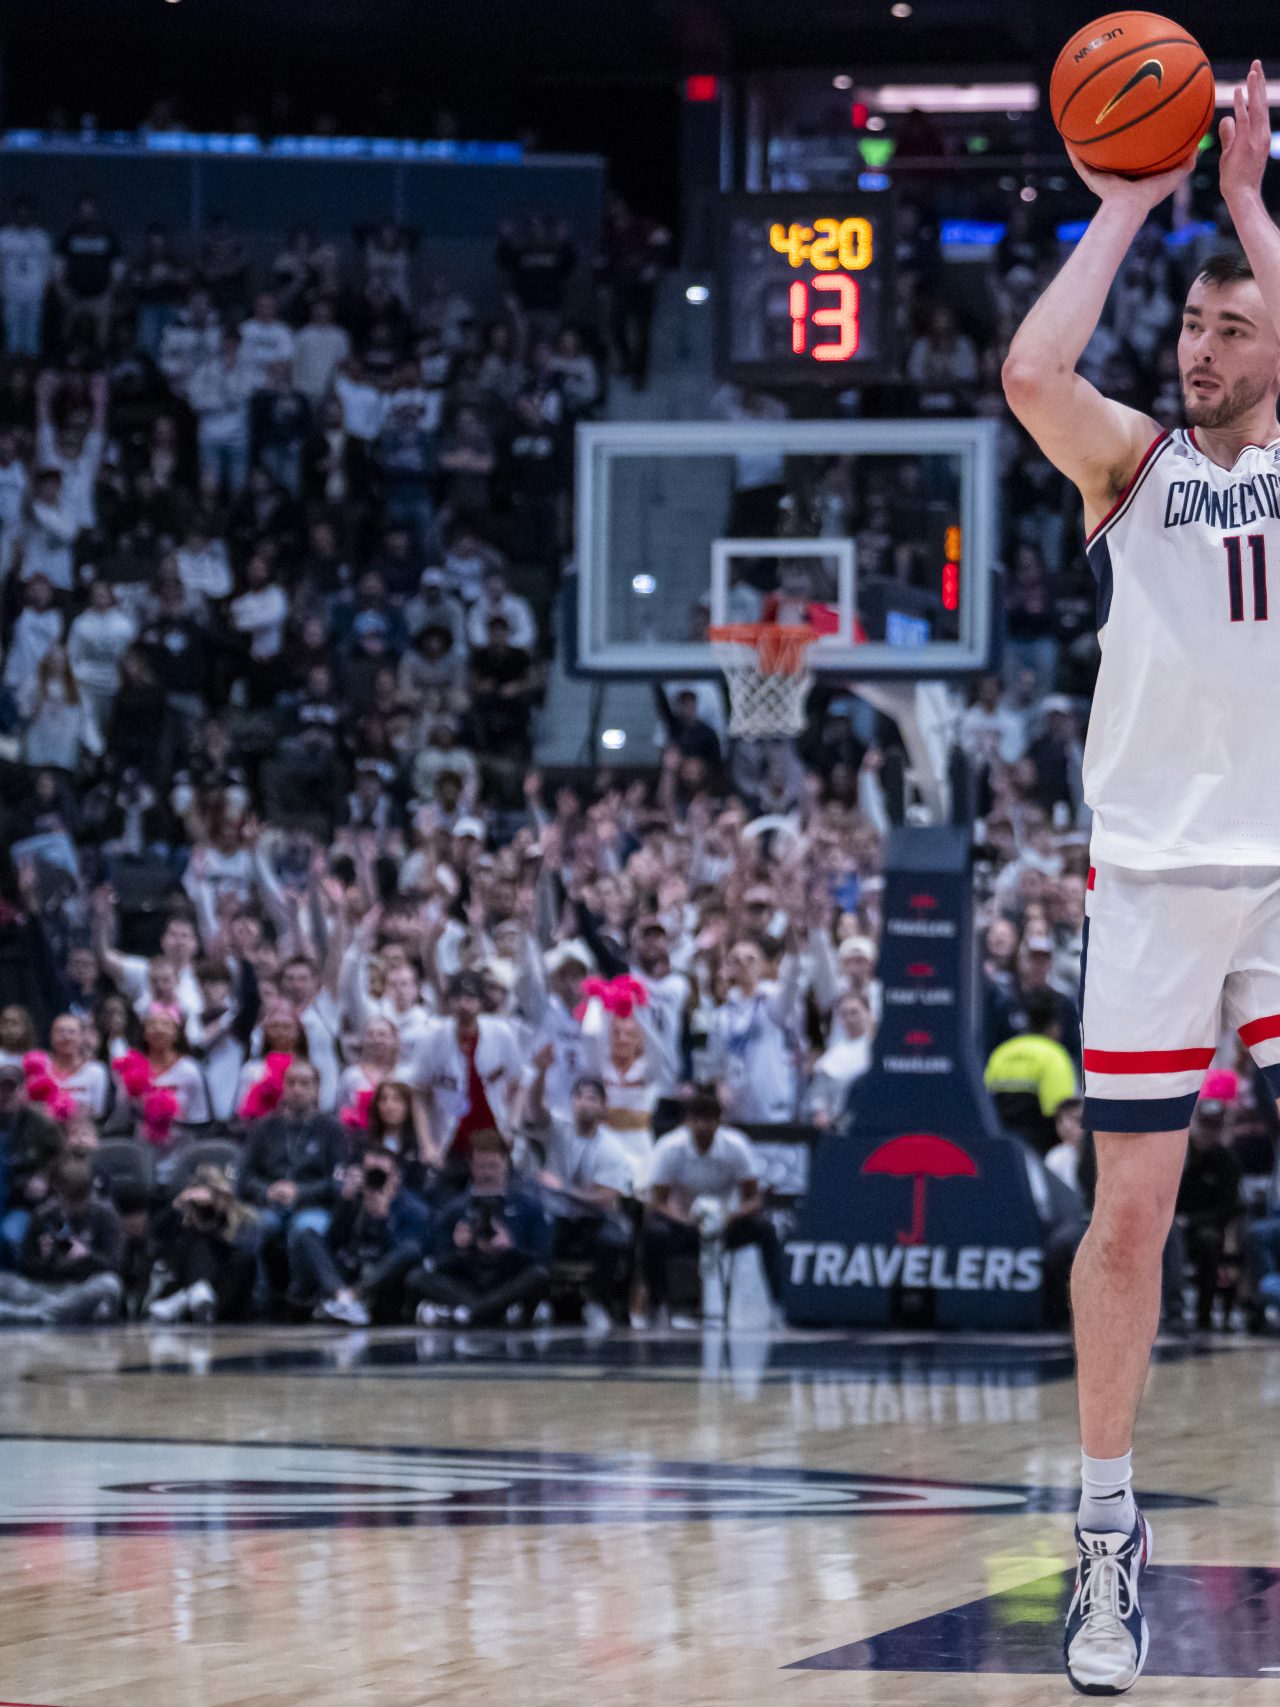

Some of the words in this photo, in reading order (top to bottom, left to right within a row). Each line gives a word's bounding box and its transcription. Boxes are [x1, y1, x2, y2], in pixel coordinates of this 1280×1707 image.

[770, 217, 873, 271] 4:20
[789, 273, 860, 362] 13
[1223, 534, 1268, 622] 11
[784, 1241, 1045, 1292] TRAVELERS
